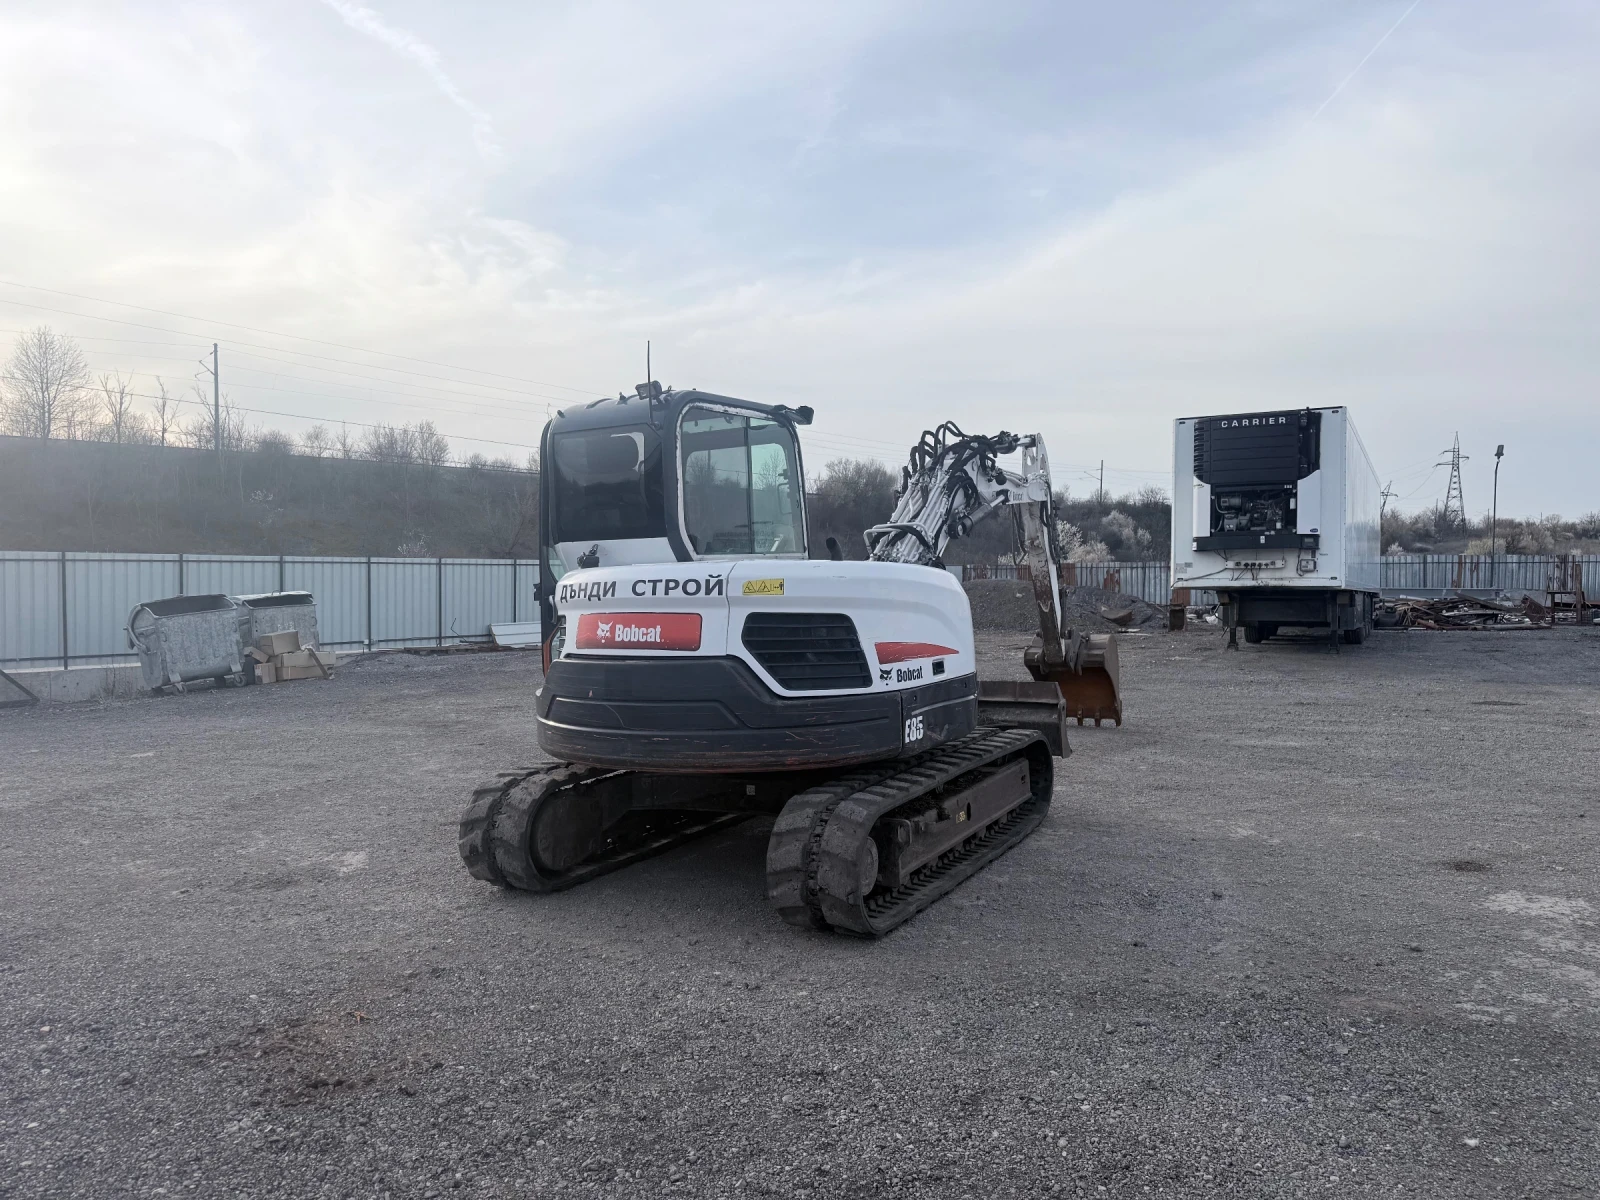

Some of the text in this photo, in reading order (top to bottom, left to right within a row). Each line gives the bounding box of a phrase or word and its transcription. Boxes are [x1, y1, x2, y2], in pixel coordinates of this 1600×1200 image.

[1221, 416, 1286, 428] CARRIER
[560, 574, 724, 603] ДЪНДИ СТРОЙ
[615, 624, 662, 642] Bobcat
[896, 666, 923, 683] Bobcat
[905, 715, 924, 744] E85
